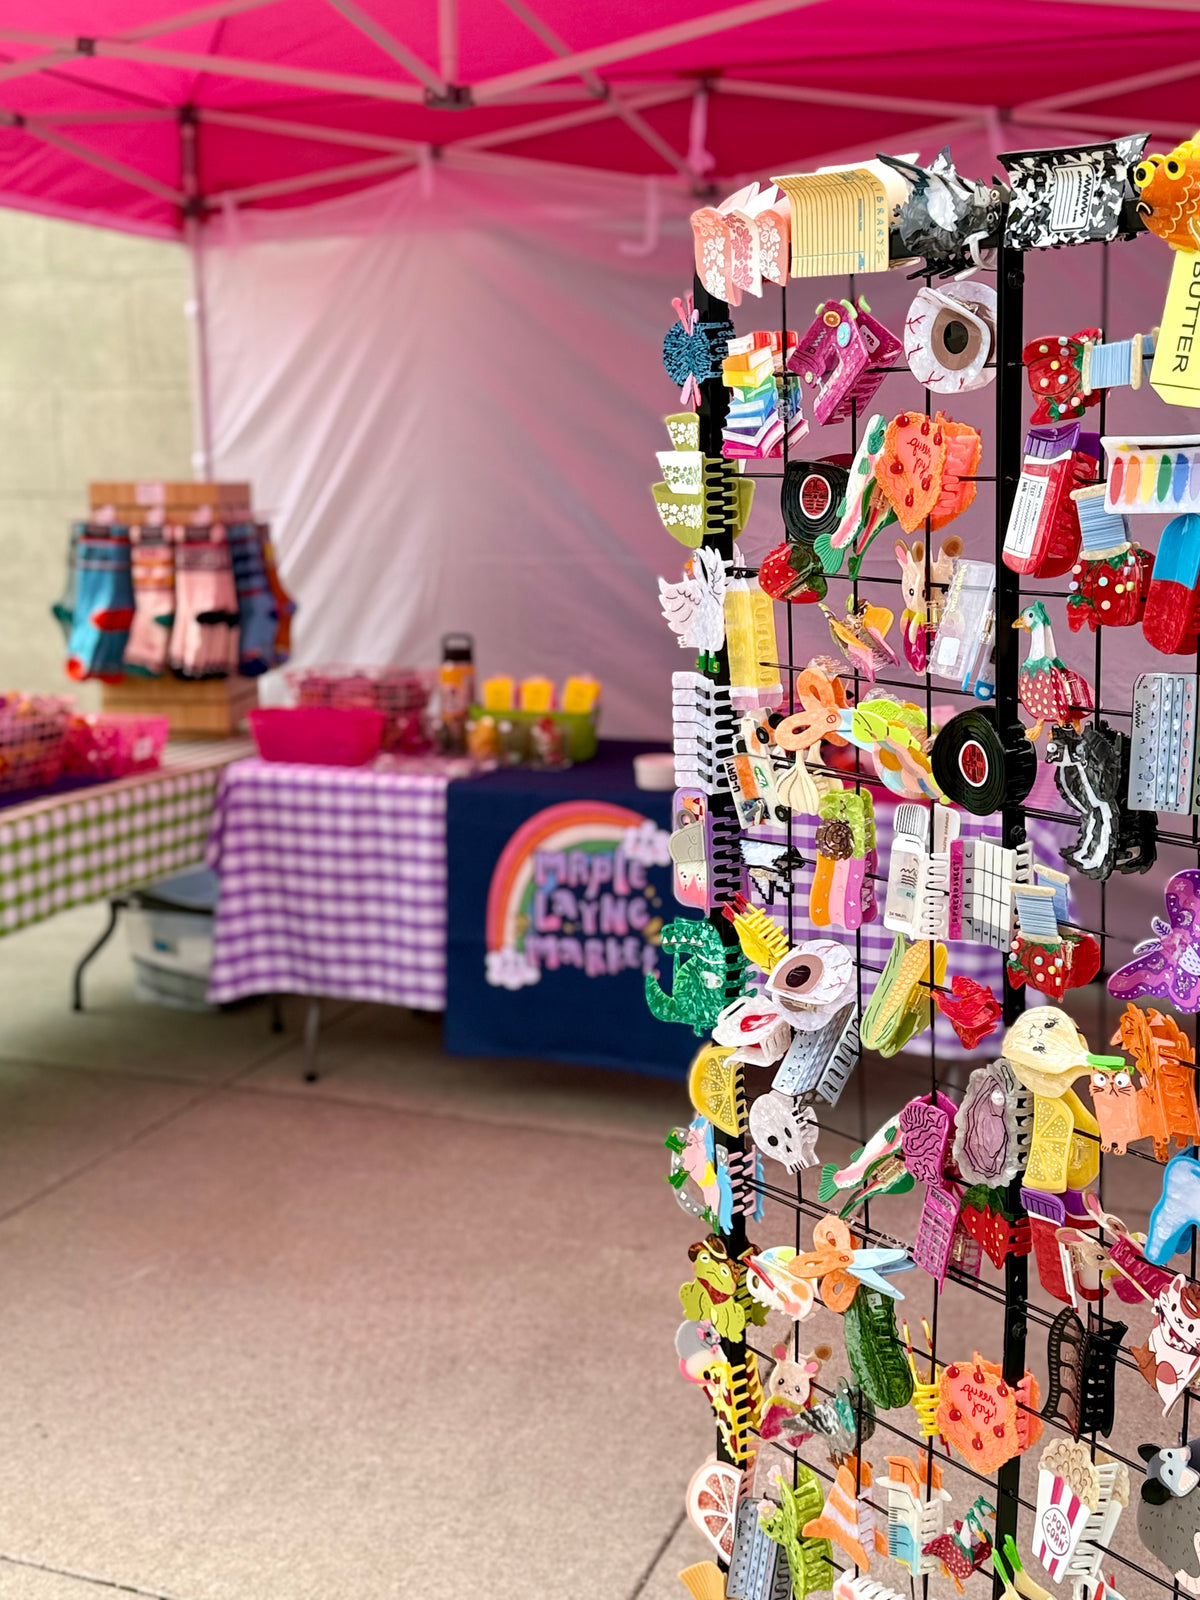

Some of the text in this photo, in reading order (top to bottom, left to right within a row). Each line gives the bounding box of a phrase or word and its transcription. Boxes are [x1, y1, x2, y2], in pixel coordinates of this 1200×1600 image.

[870, 180, 885, 247] LIBRARY
[952, 860, 961, 924] SPREADSHEET
[960, 1384, 996, 1406] queer
[972, 1400, 997, 1425] joy!
[1046, 1523, 1065, 1552] CORN
[1051, 1513, 1066, 1536] POP
